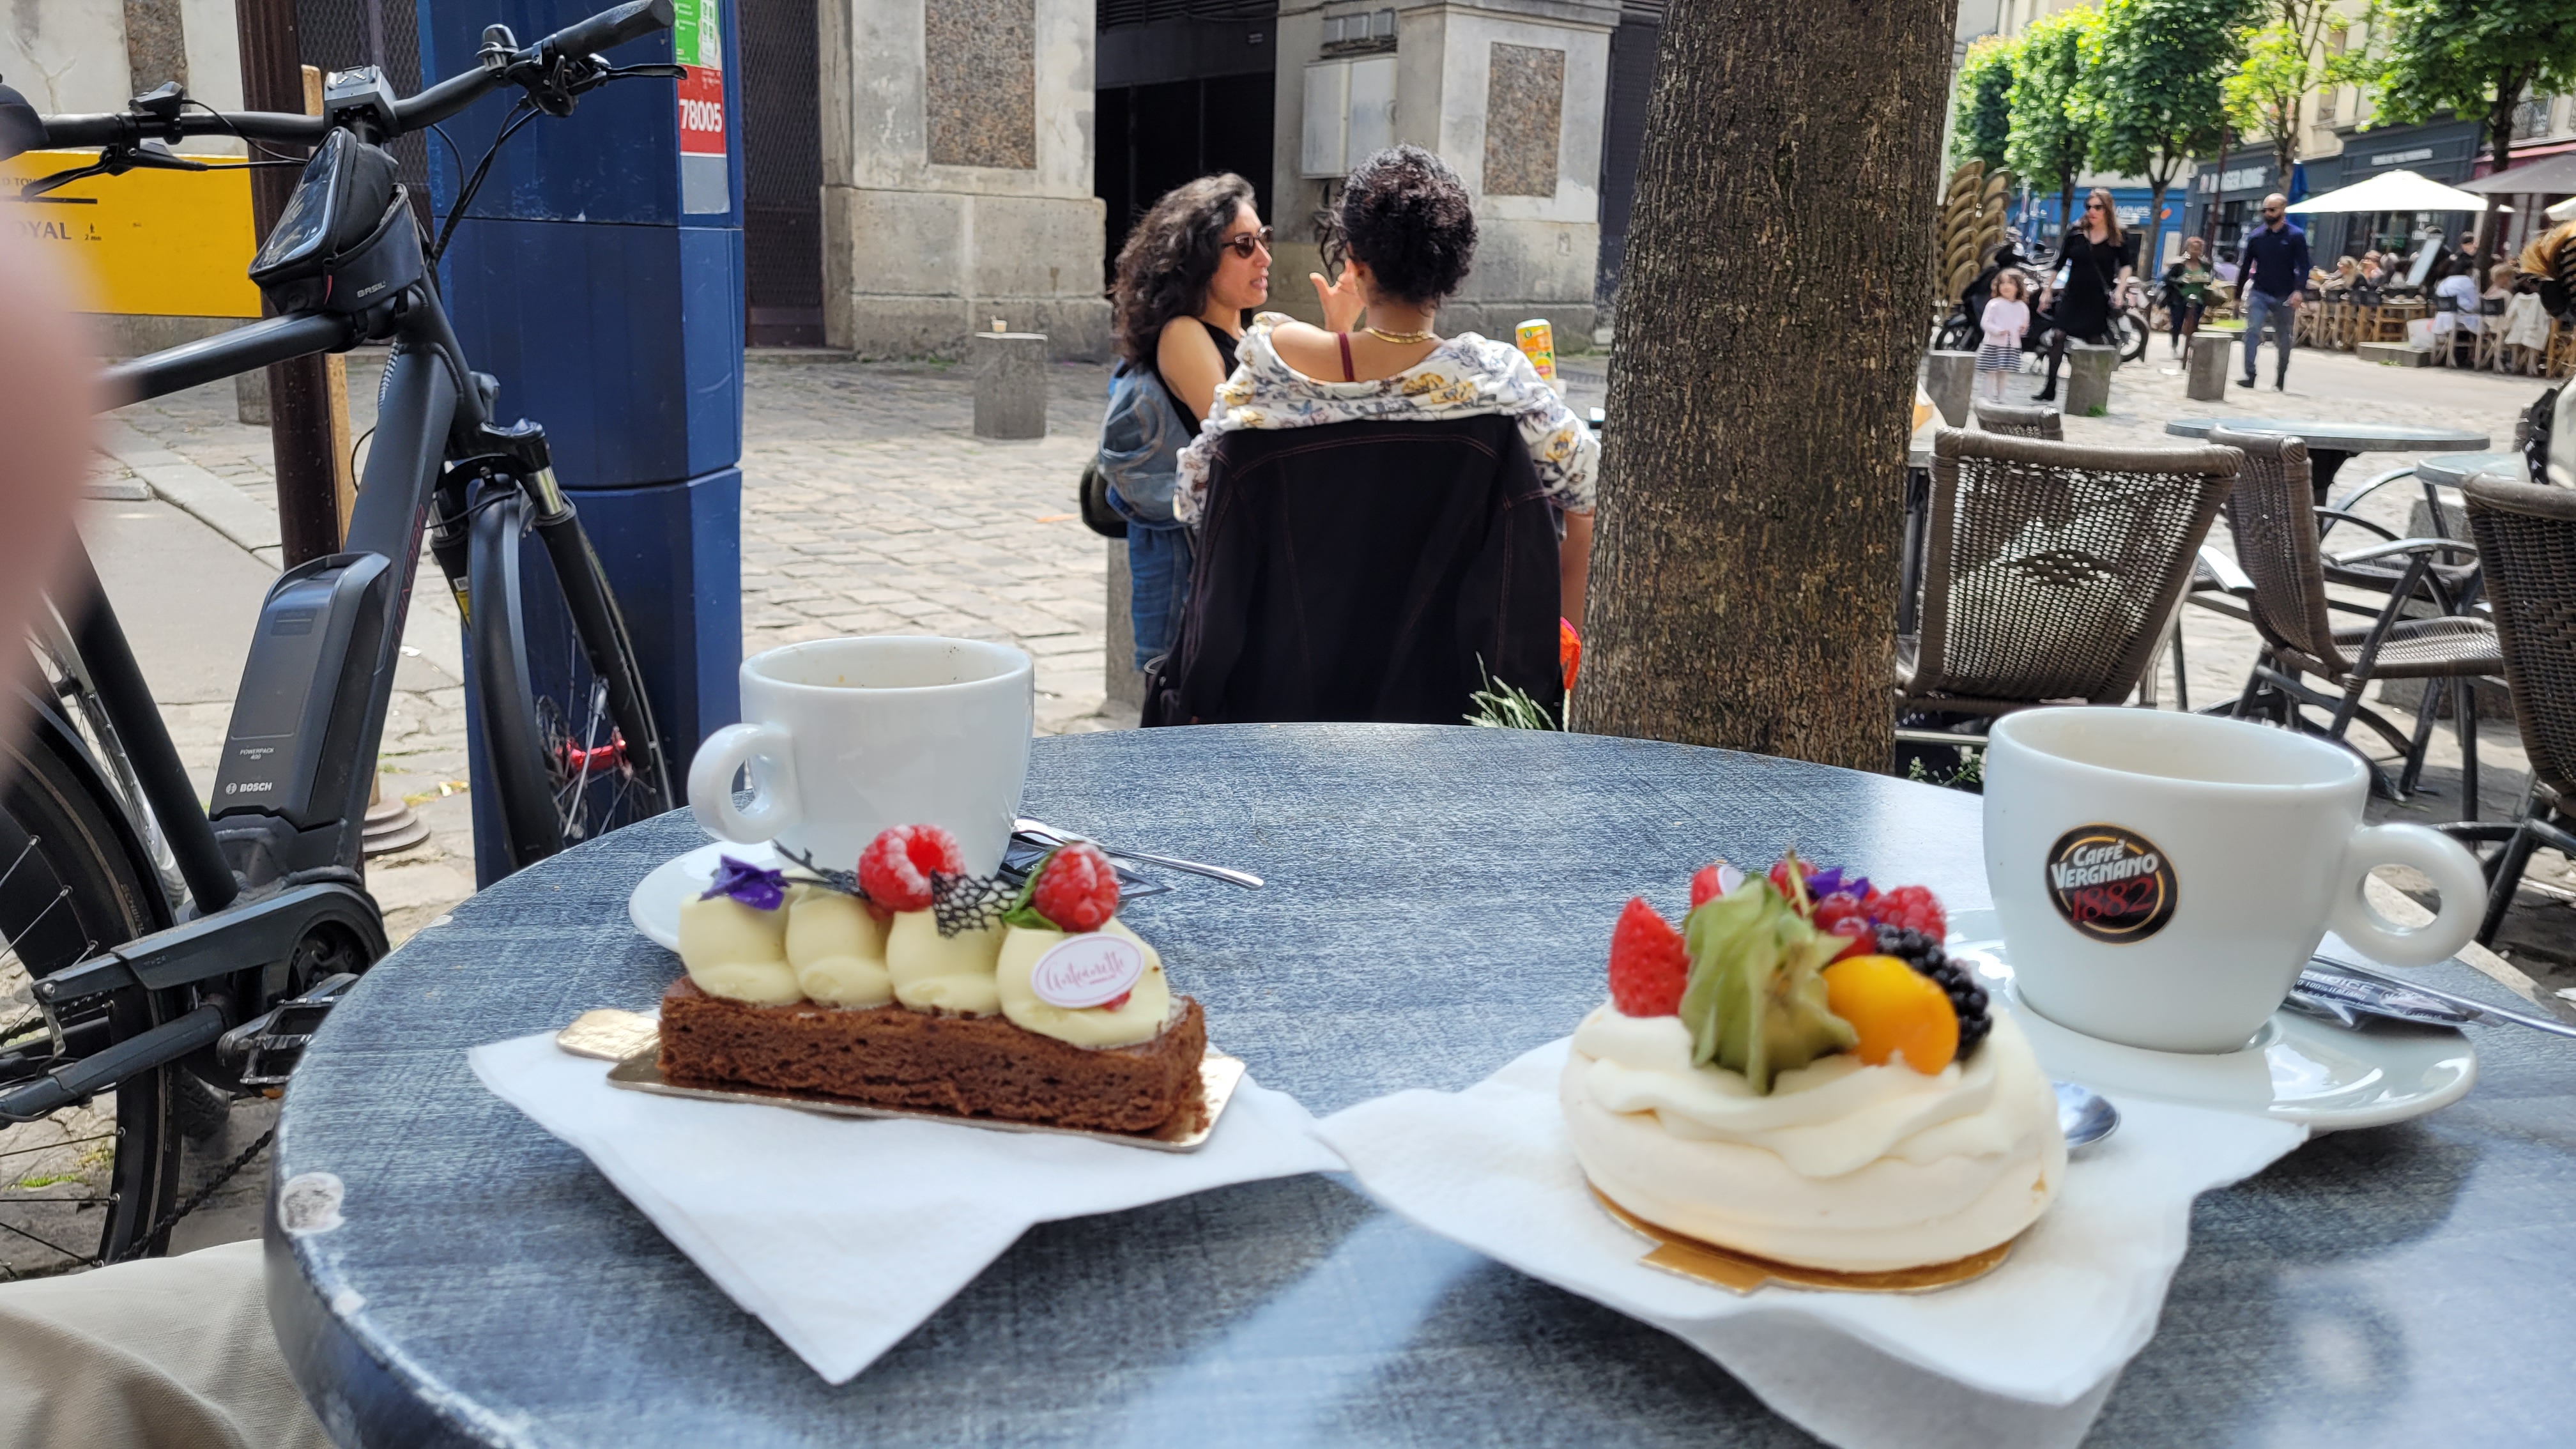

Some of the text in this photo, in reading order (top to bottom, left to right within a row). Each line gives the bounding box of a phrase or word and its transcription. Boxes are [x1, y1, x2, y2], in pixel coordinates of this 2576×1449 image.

[678, 98, 723, 133] 78005
[356, 282, 387, 298] BASIL
[240, 781, 273, 793] BOSCH
[2050, 853, 2159, 889] VERGNANO
[2073, 877, 2154, 921] 1882
[2328, 986, 2366, 1000] ITALIANO
